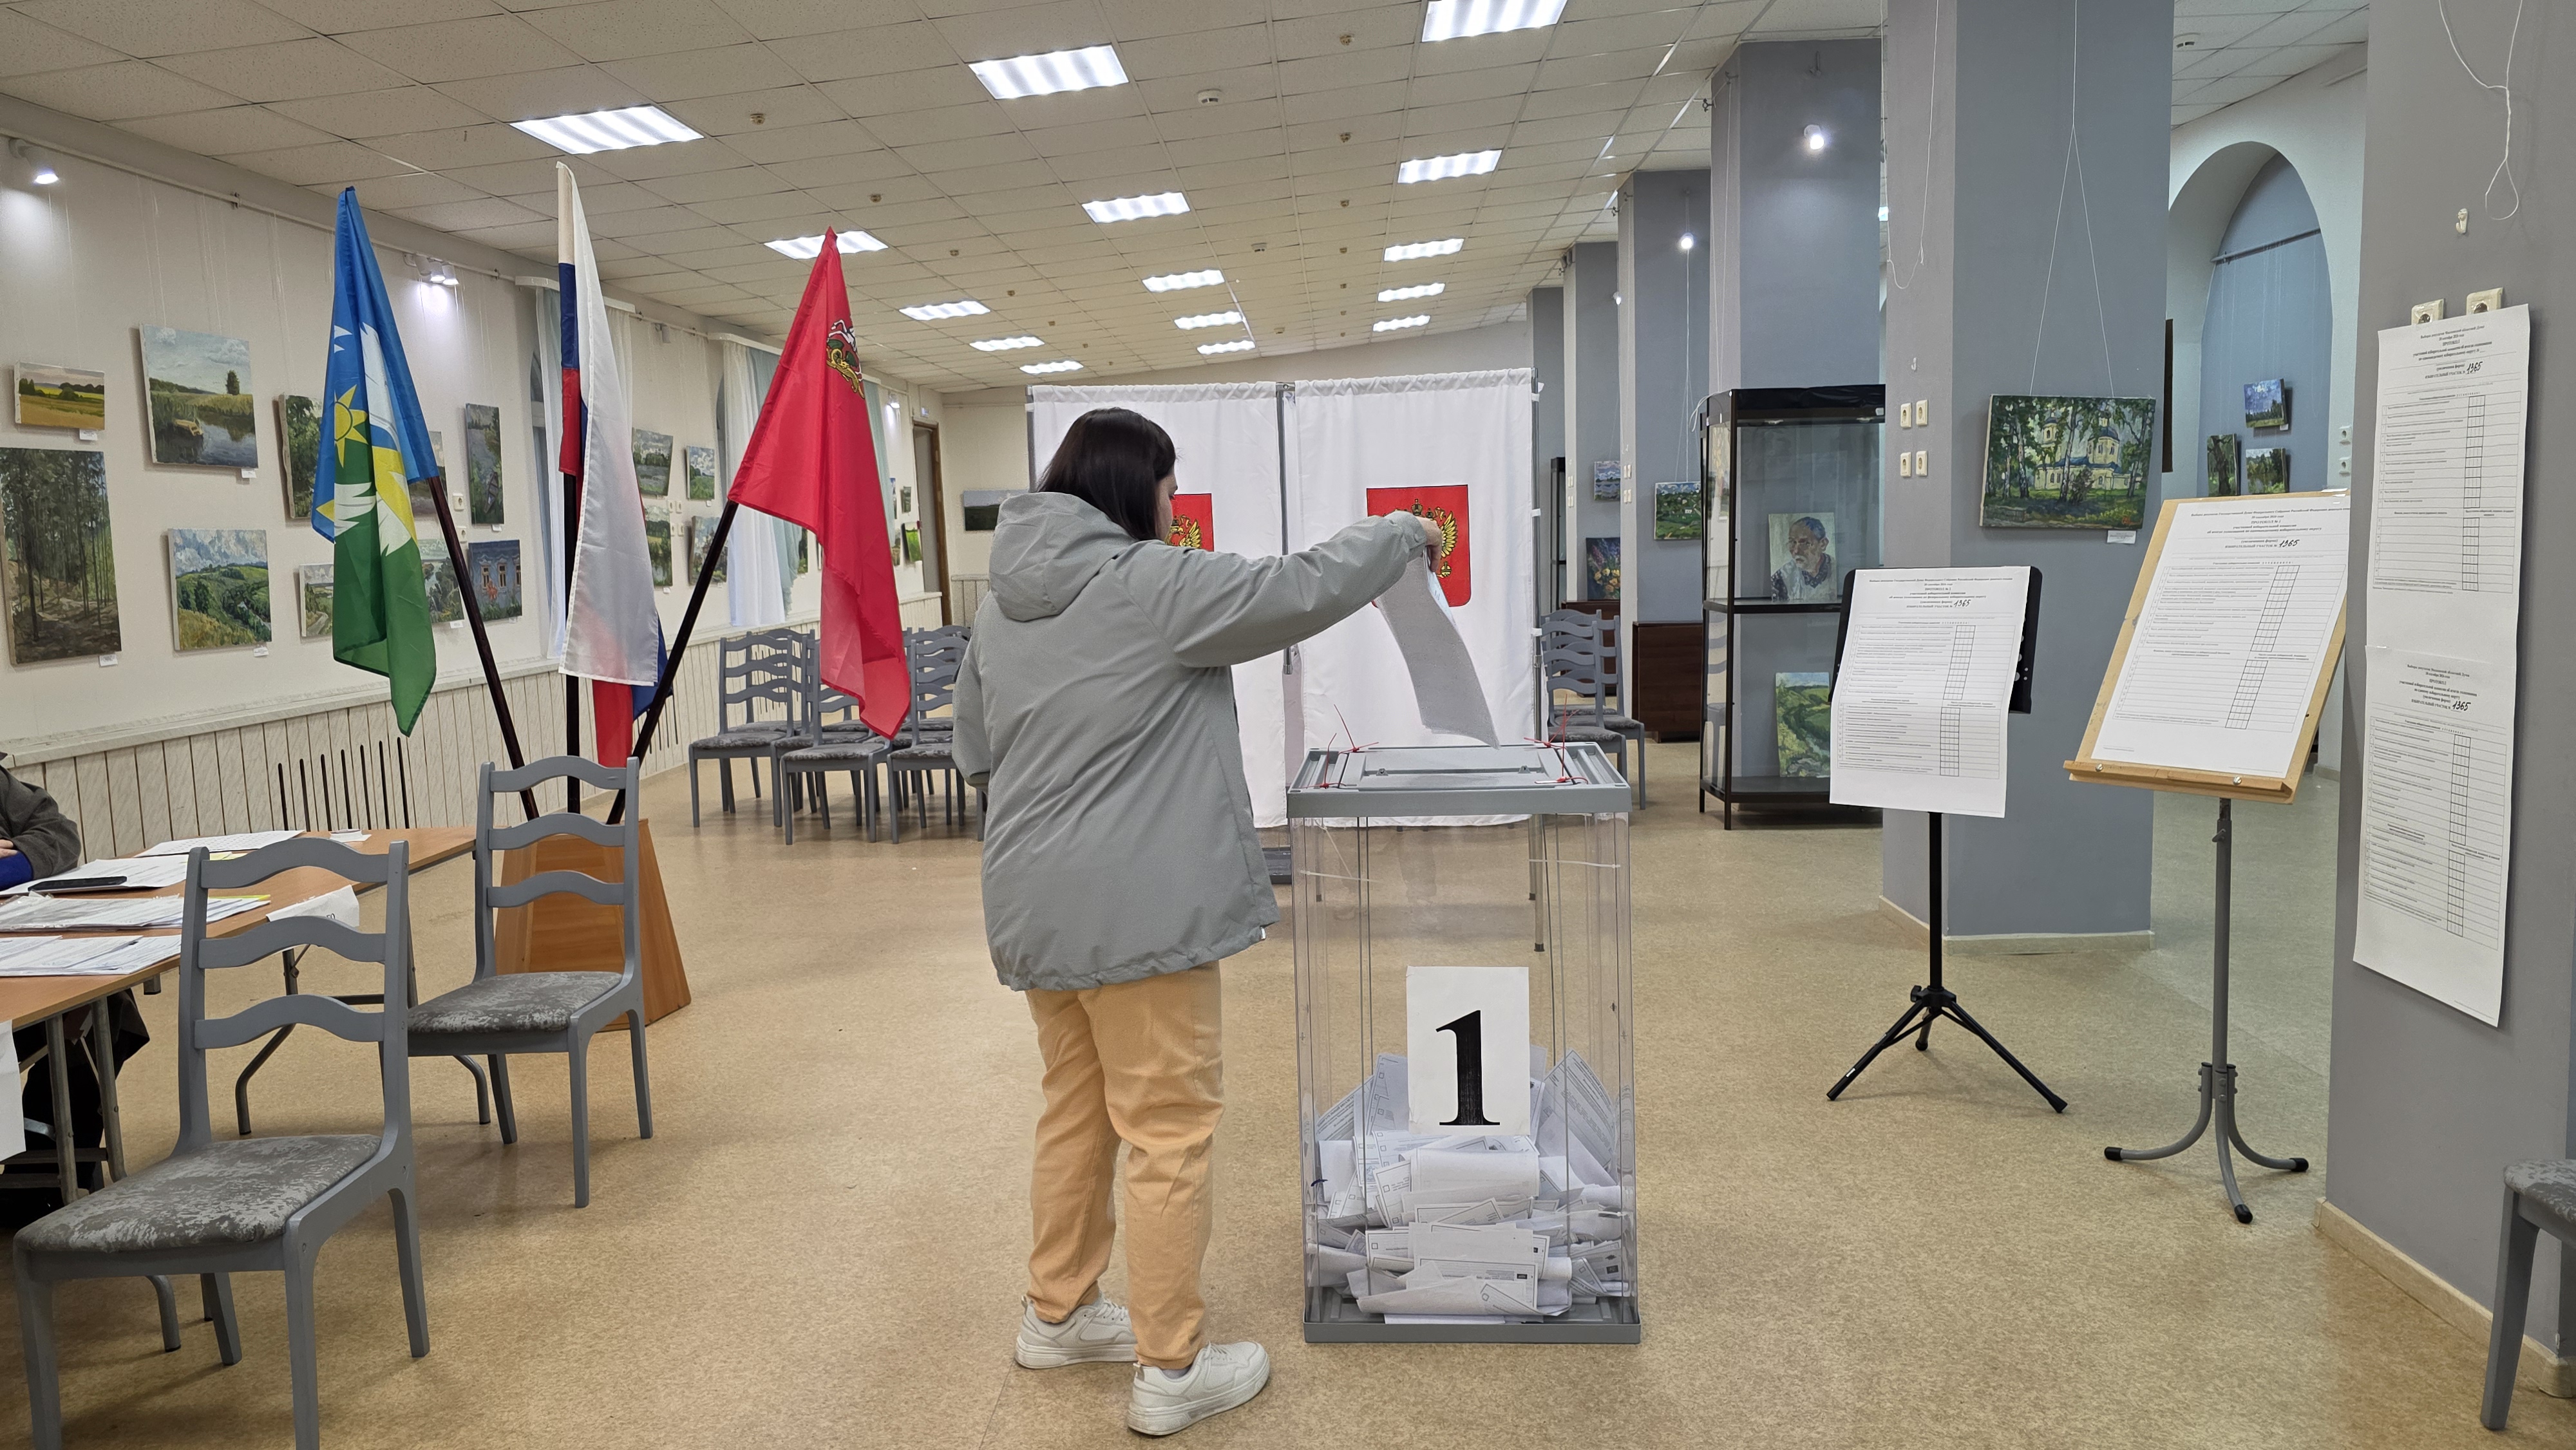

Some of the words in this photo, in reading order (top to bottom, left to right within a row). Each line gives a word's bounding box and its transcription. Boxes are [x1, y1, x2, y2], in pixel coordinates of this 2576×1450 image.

[2466, 361, 2483, 374] 1365
[2452, 701, 2471, 711] 1365
[1435, 1010, 1501, 1125] 1
